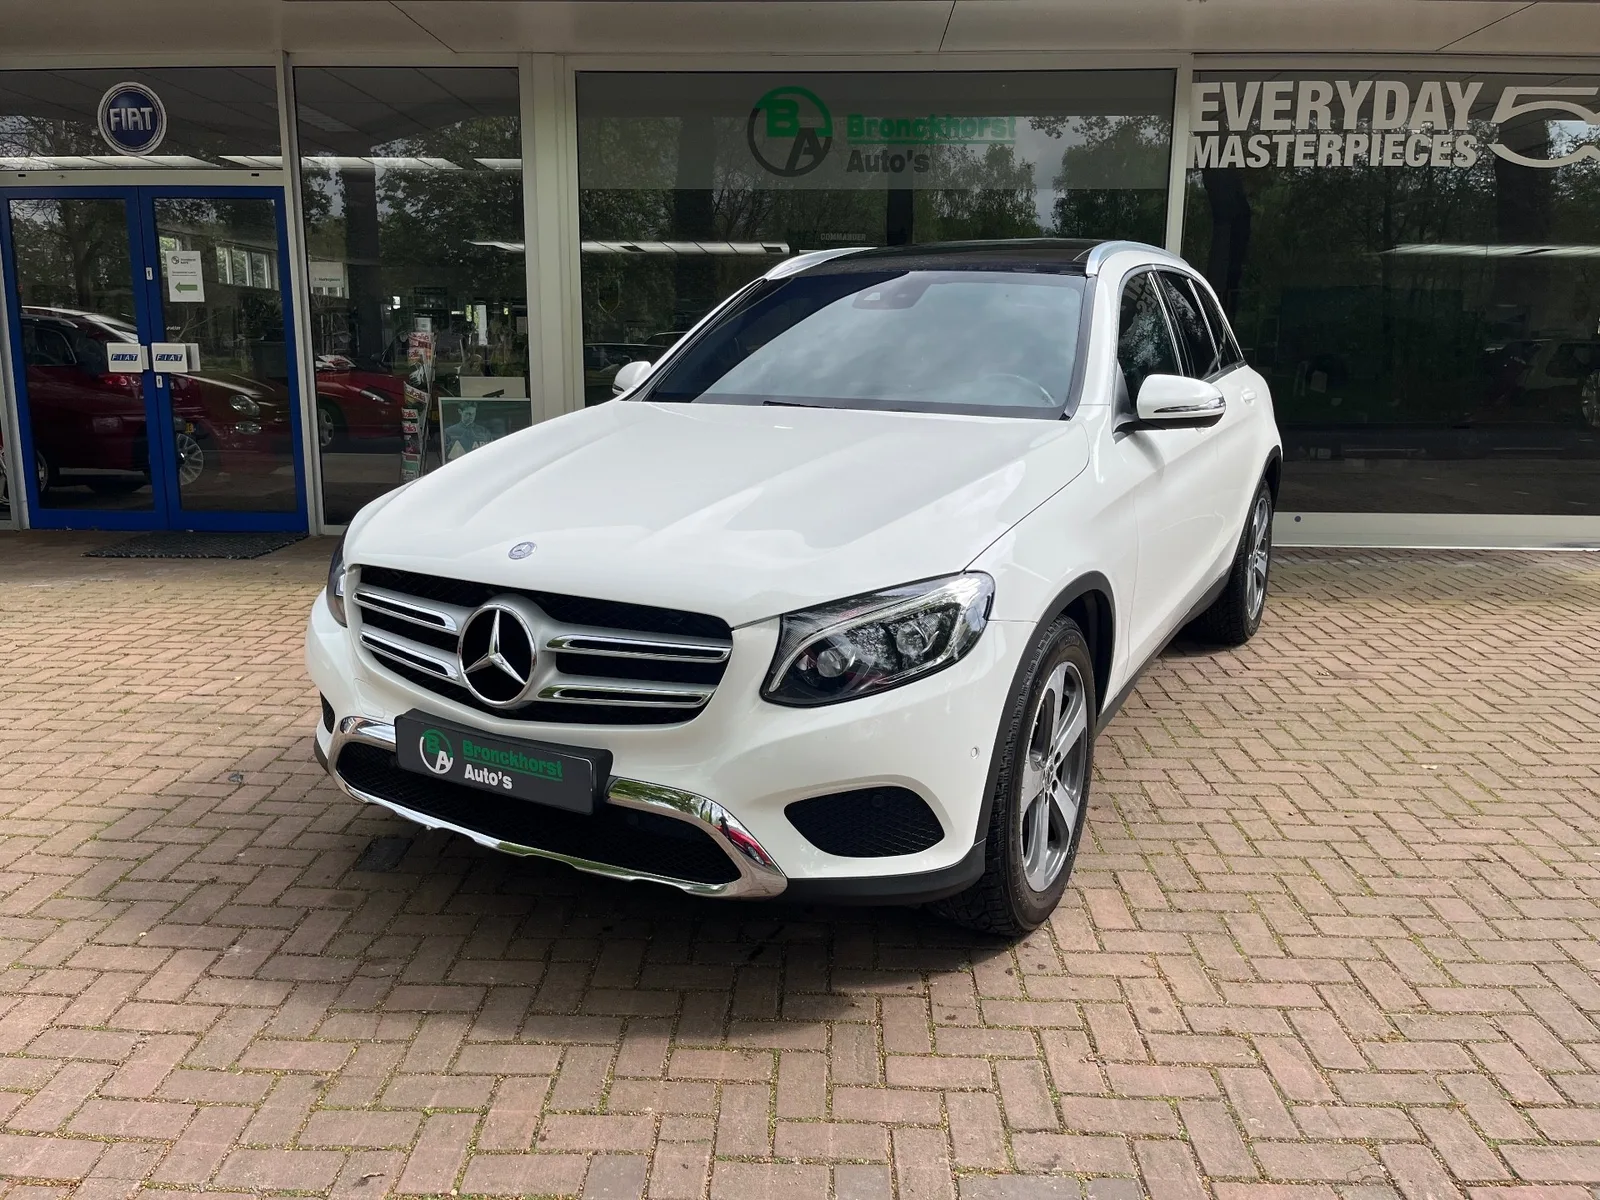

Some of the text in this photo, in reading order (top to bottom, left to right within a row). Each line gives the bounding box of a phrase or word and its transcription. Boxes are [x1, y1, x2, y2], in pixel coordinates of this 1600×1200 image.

[109, 107, 153, 131] FIAT
[1189, 81, 1483, 132] EVERYDAY
[846, 113, 1017, 138] Bronckhorst
[846, 150, 930, 173] Auto's
[1186, 134, 1478, 168] MASTERPIECES
[111, 353, 138, 361] FIAT
[155, 353, 183, 361] FIAT
[462, 740, 563, 778] Bronckhorst
[464, 764, 513, 790] Auto's
